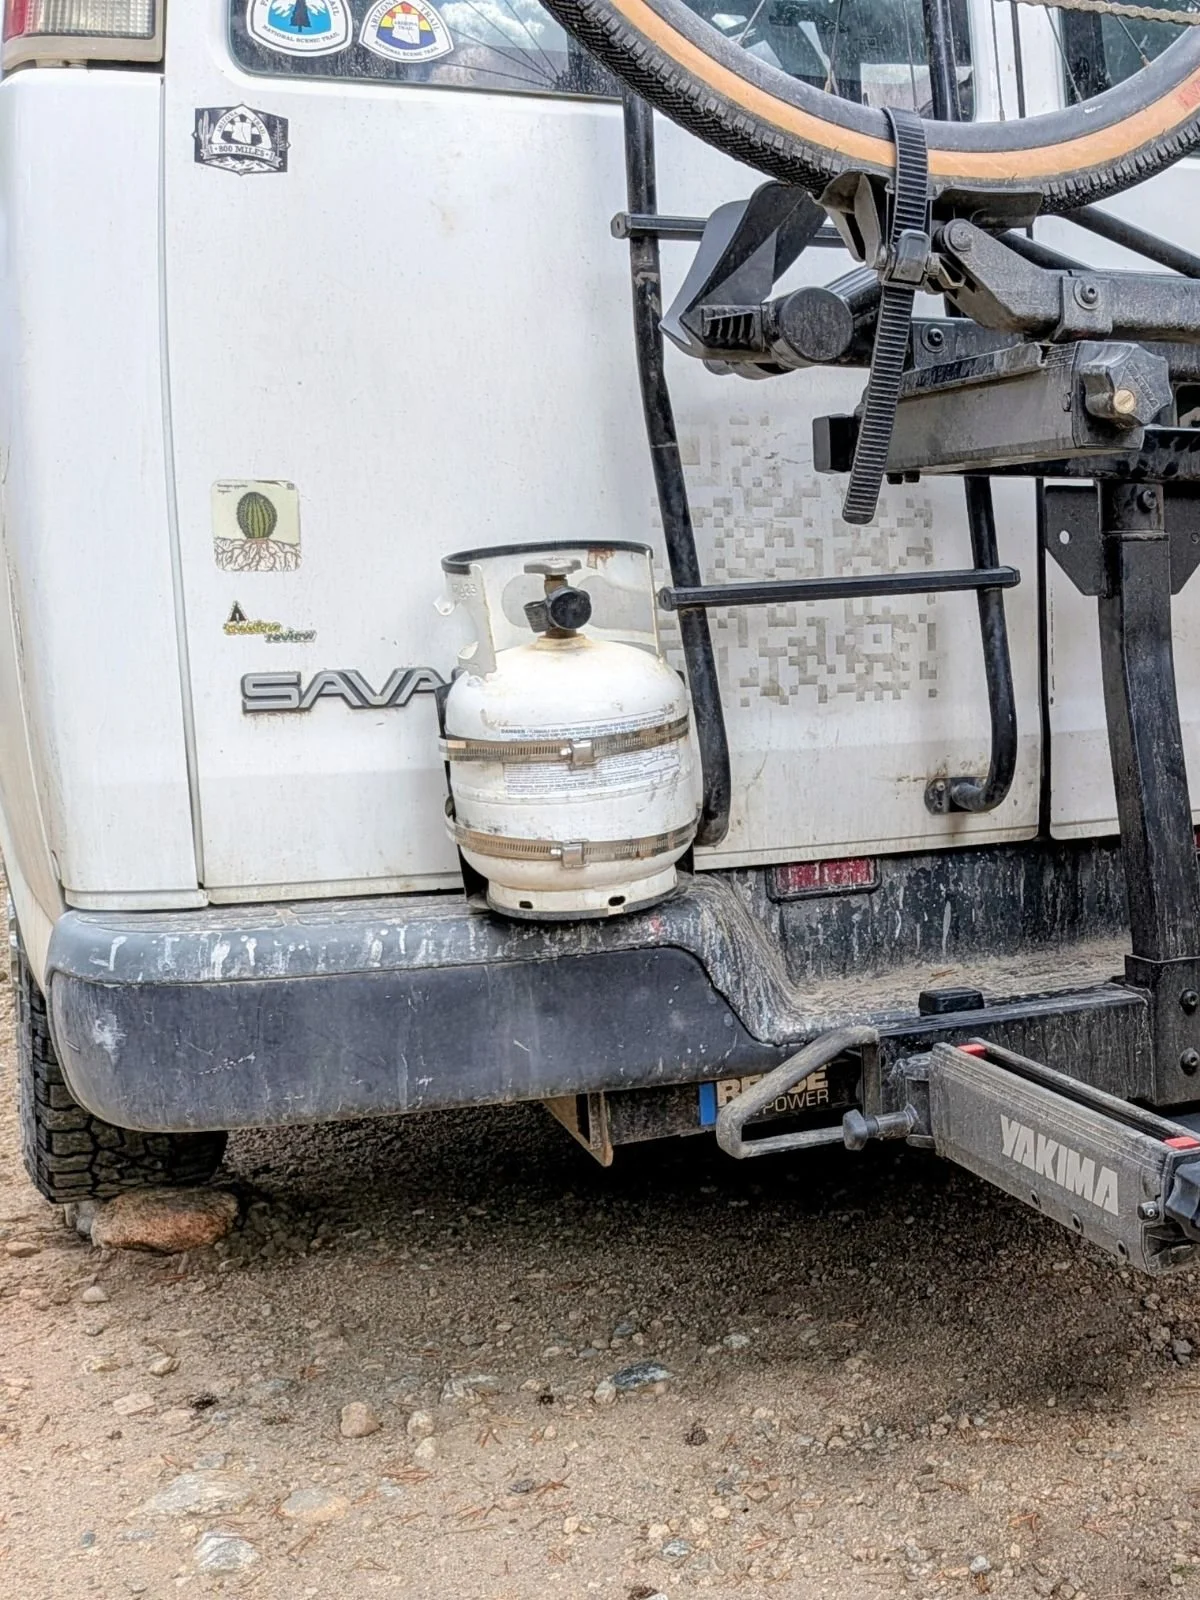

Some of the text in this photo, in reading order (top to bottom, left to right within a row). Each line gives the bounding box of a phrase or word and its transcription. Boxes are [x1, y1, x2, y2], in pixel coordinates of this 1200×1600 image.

[420, 5, 440, 32] TRAIL
[262, 24, 295, 42] NATIONAL
[321, 32, 340, 42] TRAIL
[374, 40, 401, 55] NATIONAL
[424, 46, 439, 55] TRAIL
[218, 145, 265, 157] 800 MILES
[241, 667, 463, 714] SAVA
[1000, 1114, 1119, 1217] YAKIMA
